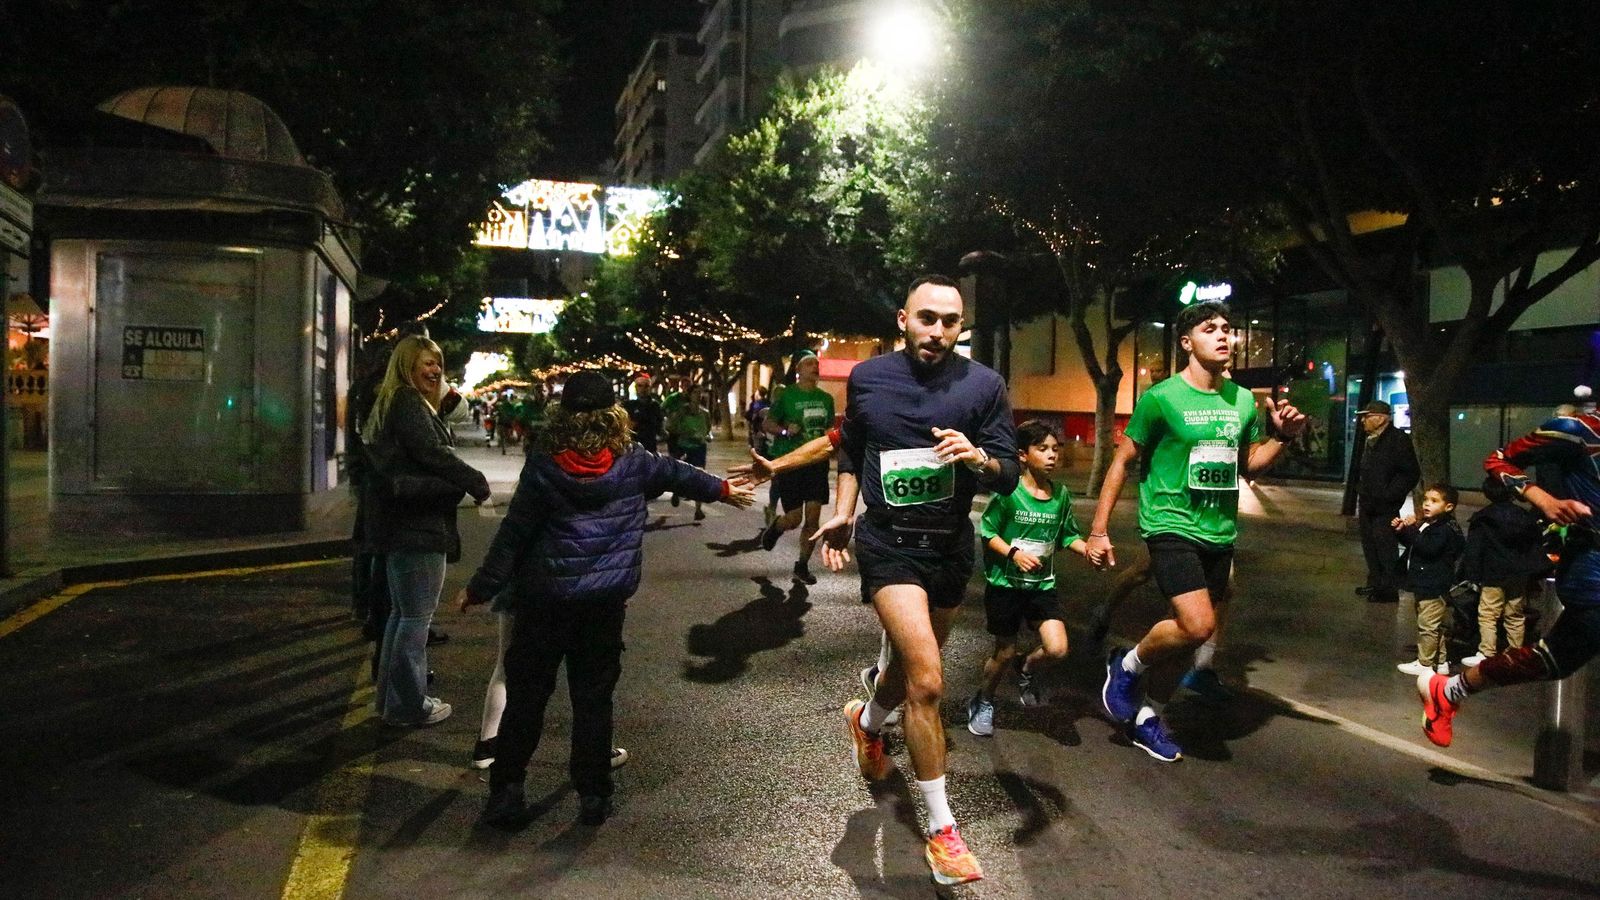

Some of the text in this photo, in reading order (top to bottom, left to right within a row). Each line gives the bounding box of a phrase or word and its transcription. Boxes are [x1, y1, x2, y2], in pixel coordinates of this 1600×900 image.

[125, 330, 202, 348] SE ALQUILA
[1199, 469, 1229, 483] 869
[893, 477, 940, 497] 698
